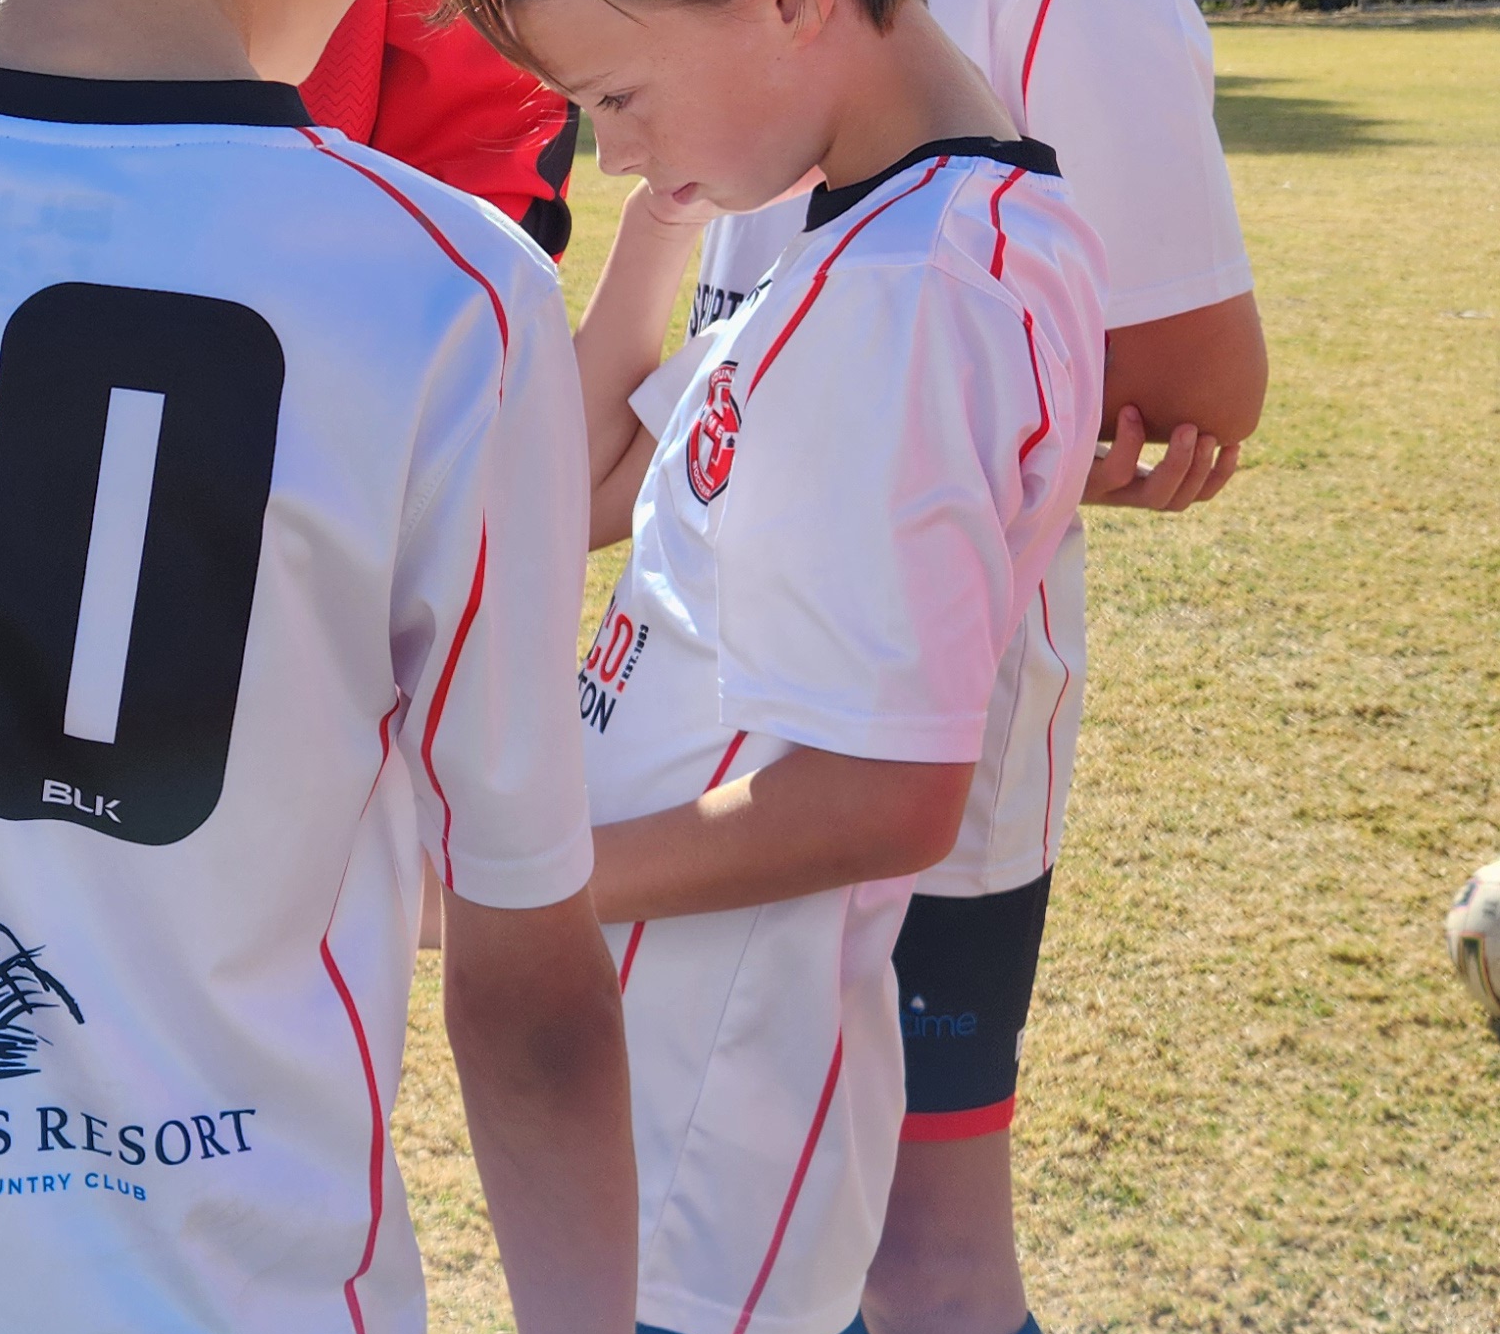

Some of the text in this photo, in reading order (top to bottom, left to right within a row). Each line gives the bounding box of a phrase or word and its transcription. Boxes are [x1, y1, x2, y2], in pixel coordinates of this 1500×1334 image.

[42, 778, 122, 823] BLK
[36, 1106, 256, 1166] RESORT
[84, 1173, 147, 1201] CLUB
